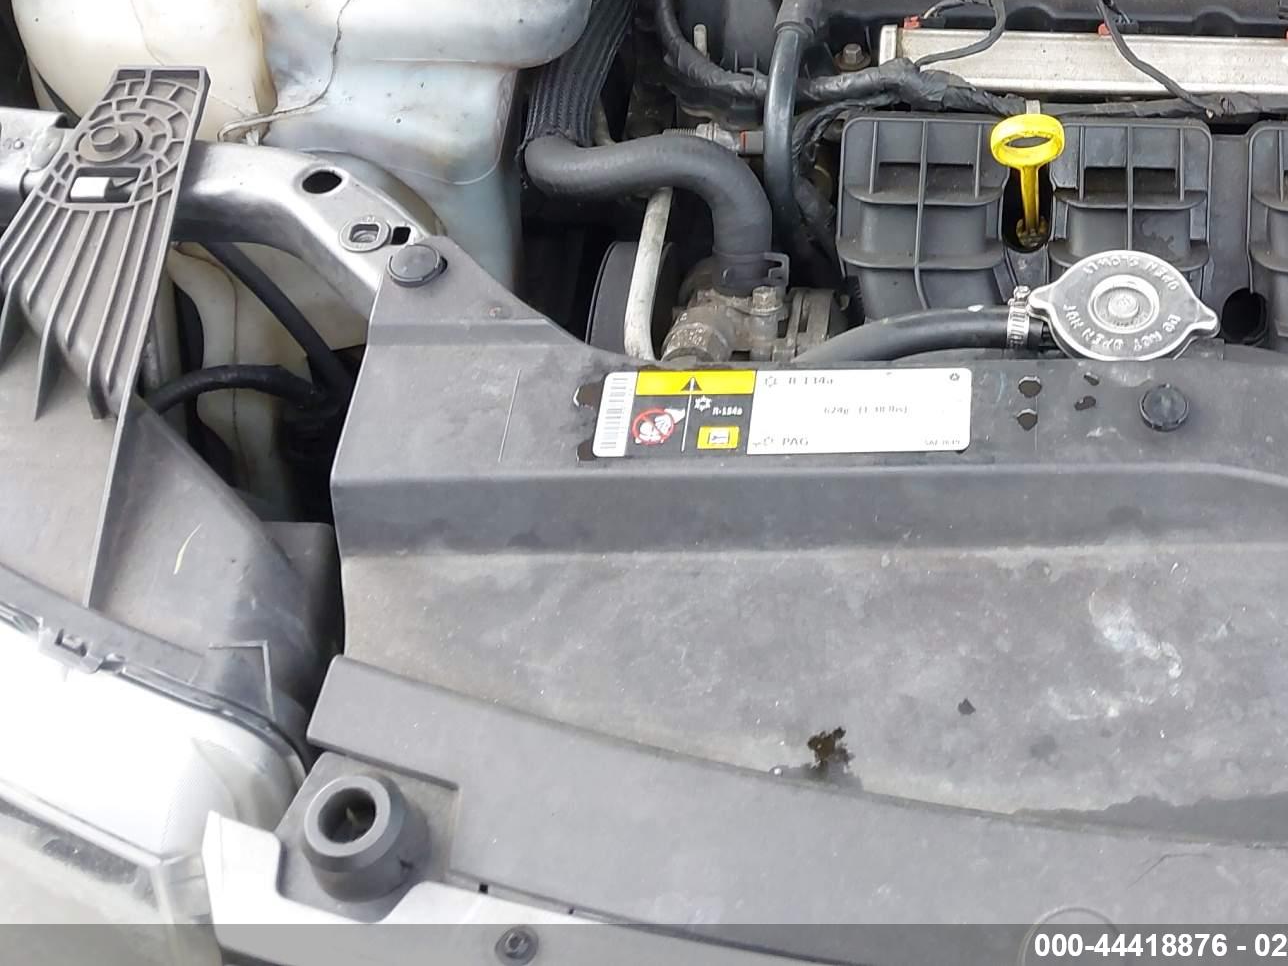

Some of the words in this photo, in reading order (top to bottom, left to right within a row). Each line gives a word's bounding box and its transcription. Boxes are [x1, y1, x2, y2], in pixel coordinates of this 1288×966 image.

[1083, 255, 1140, 275] SLOWLY
[1162, 313, 1182, 333] DO
[1082, 328, 1125, 351] OPEN
[1134, 330, 1164, 352] NOT
